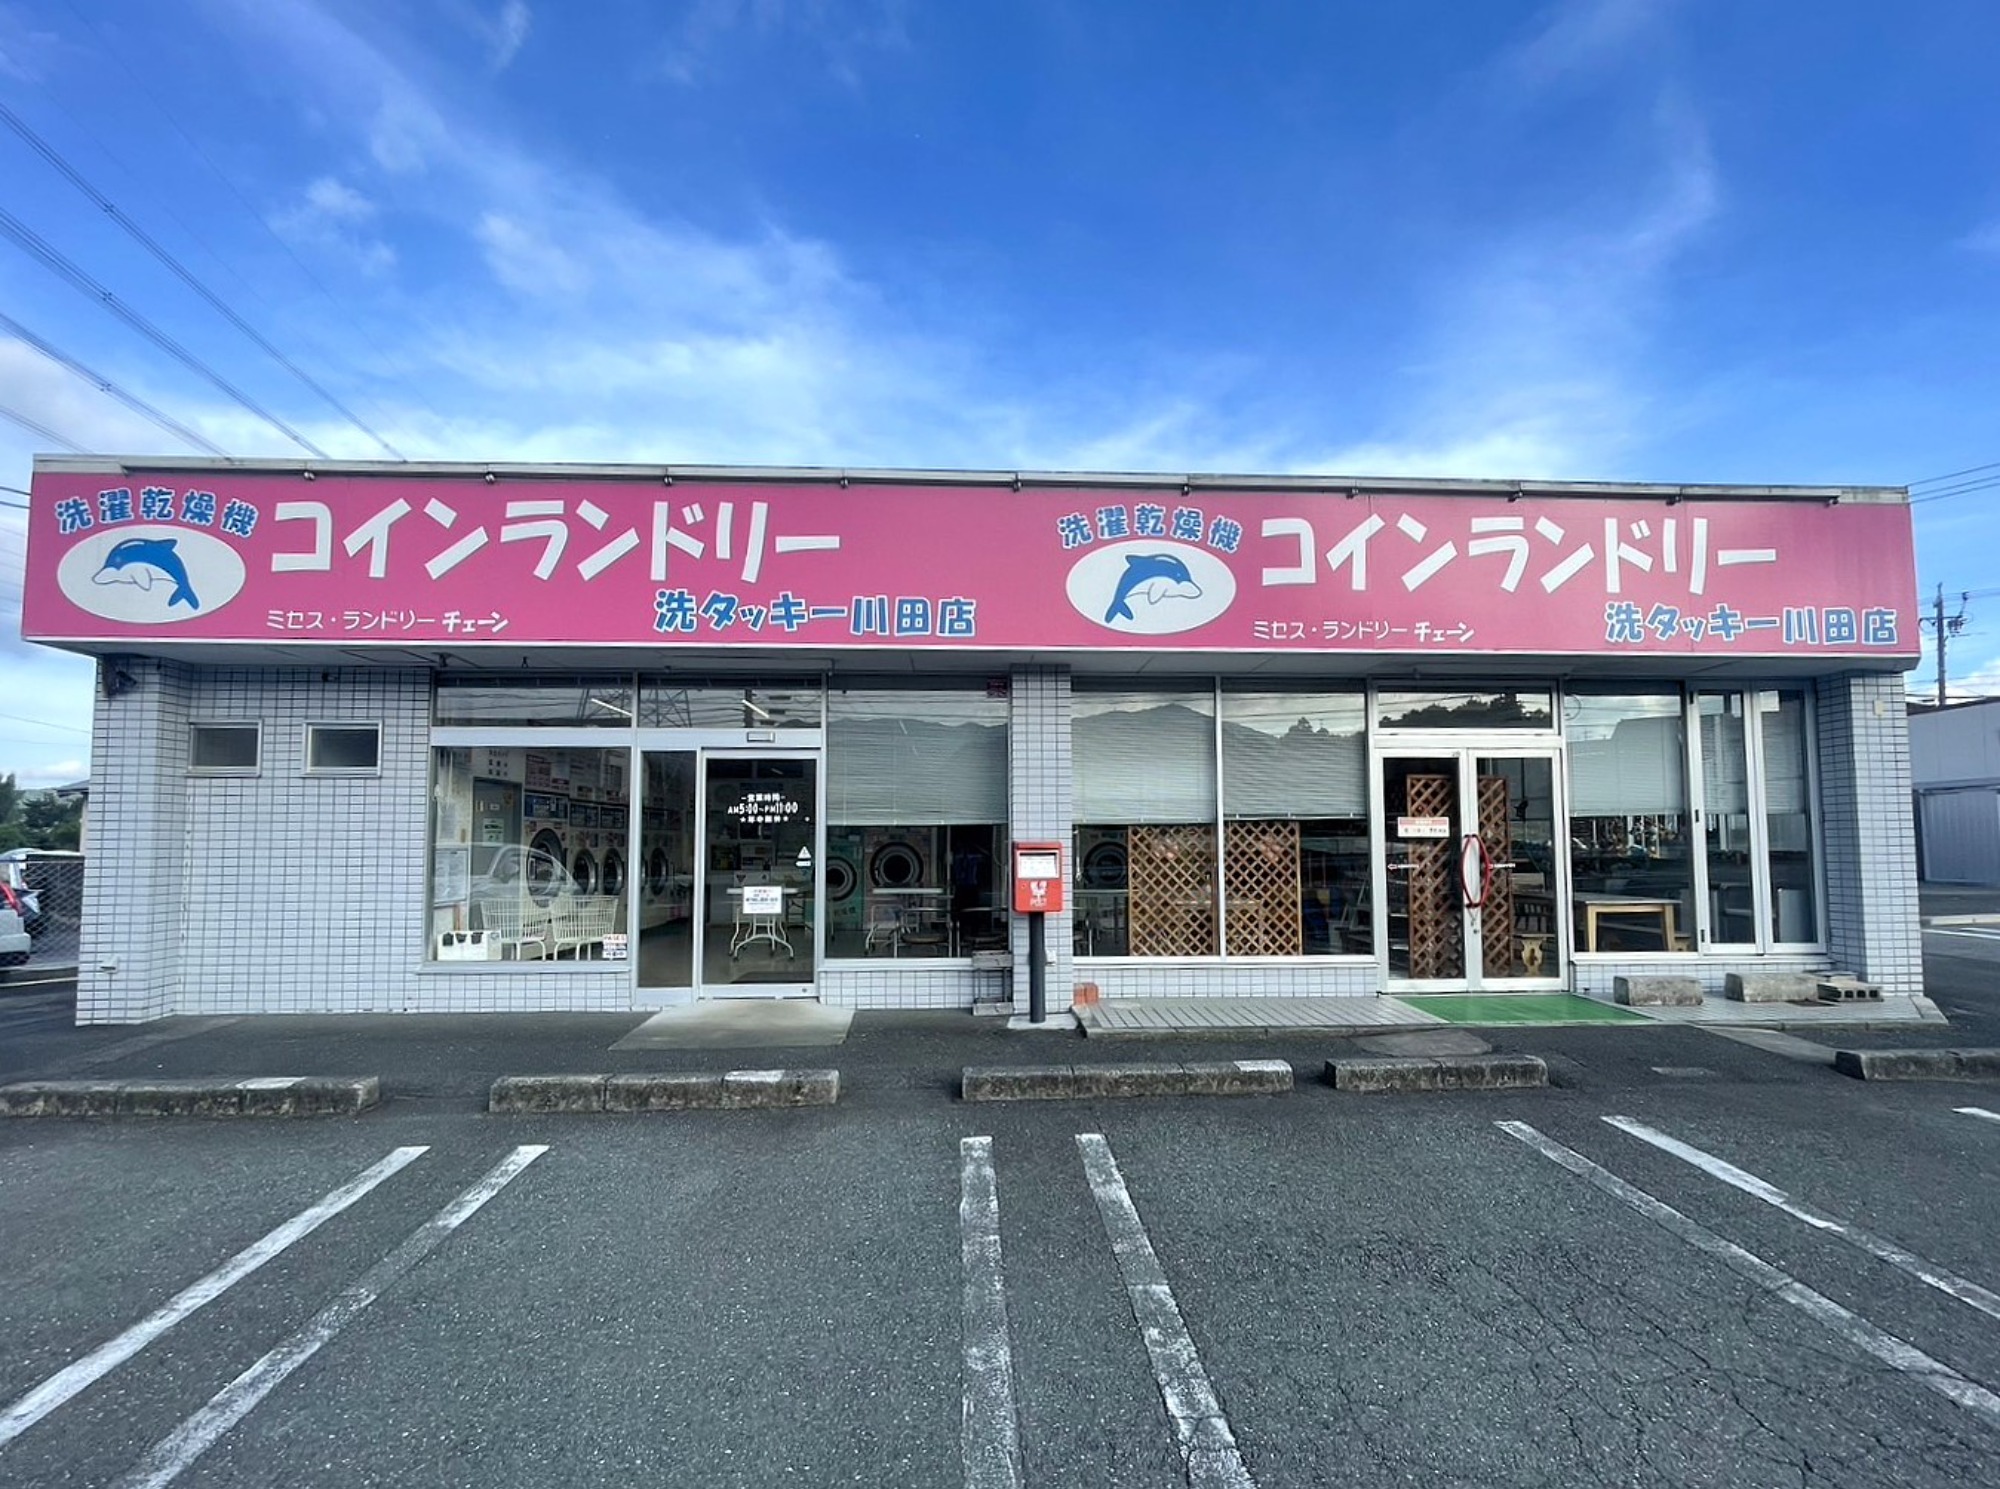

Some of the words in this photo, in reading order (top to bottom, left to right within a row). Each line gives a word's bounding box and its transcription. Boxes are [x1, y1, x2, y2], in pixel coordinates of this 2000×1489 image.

[55, 486, 259, 538] 洗濯乾燥機
[1057, 503, 1243, 554] 洗濯乾燥機
[271, 497, 840, 584] コインランドリー
[1260, 512, 1777, 595] コインランドリー
[653, 588, 977, 638] 洗タッキー川田店
[1603, 601, 1898, 645] 洗タッキー川田店
